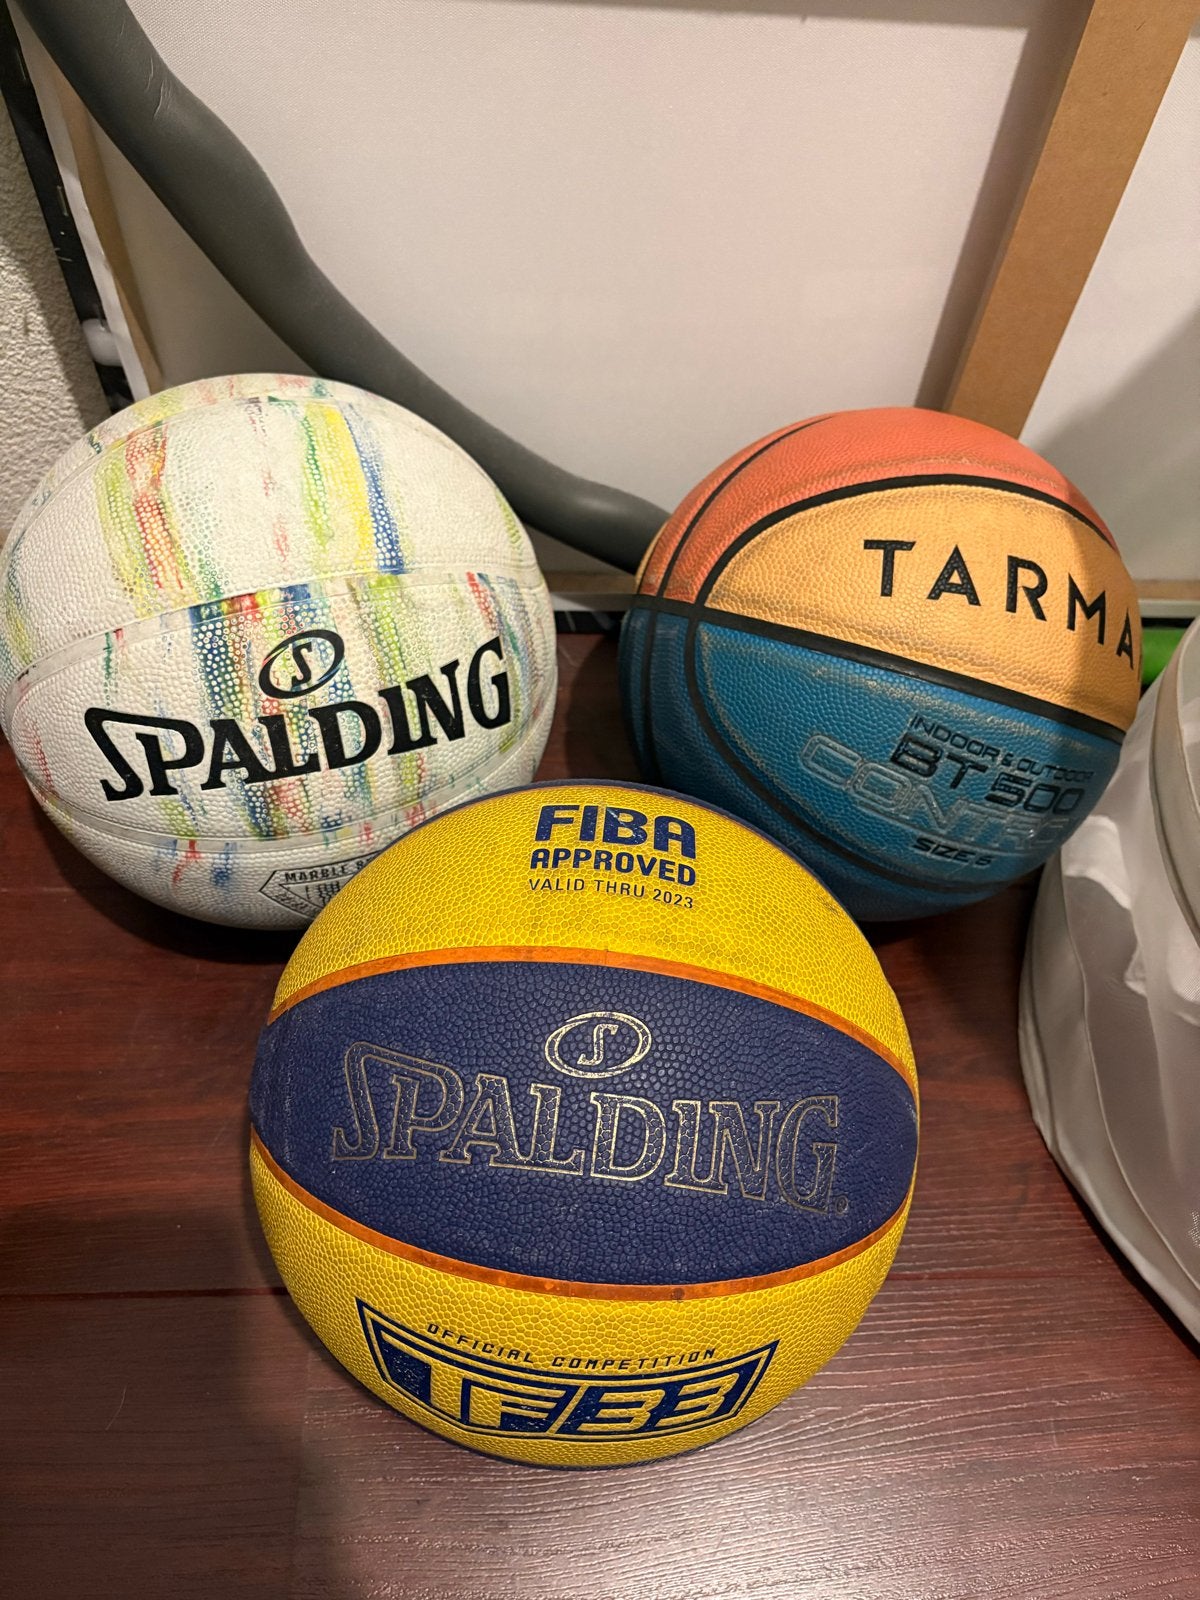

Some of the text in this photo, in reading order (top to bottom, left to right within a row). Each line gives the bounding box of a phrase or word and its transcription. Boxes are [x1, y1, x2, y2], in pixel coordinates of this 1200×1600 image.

[863, 540, 1142, 683] TARMA
[85, 637, 512, 801] SPALDING
[911, 714, 999, 761] INDOOR
[890, 733, 1085, 814] BT 500
[535, 805, 696, 859] FIBA
[912, 837, 976, 863] SIZE
[284, 865, 347, 882] MARBLE
[530, 848, 696, 886] APPROVED
[529, 878, 693, 909] VALID THRU 2023
[332, 1041, 840, 1214] SPALDING
[427, 1323, 716, 1370] OFFICIAL COMPETITION
